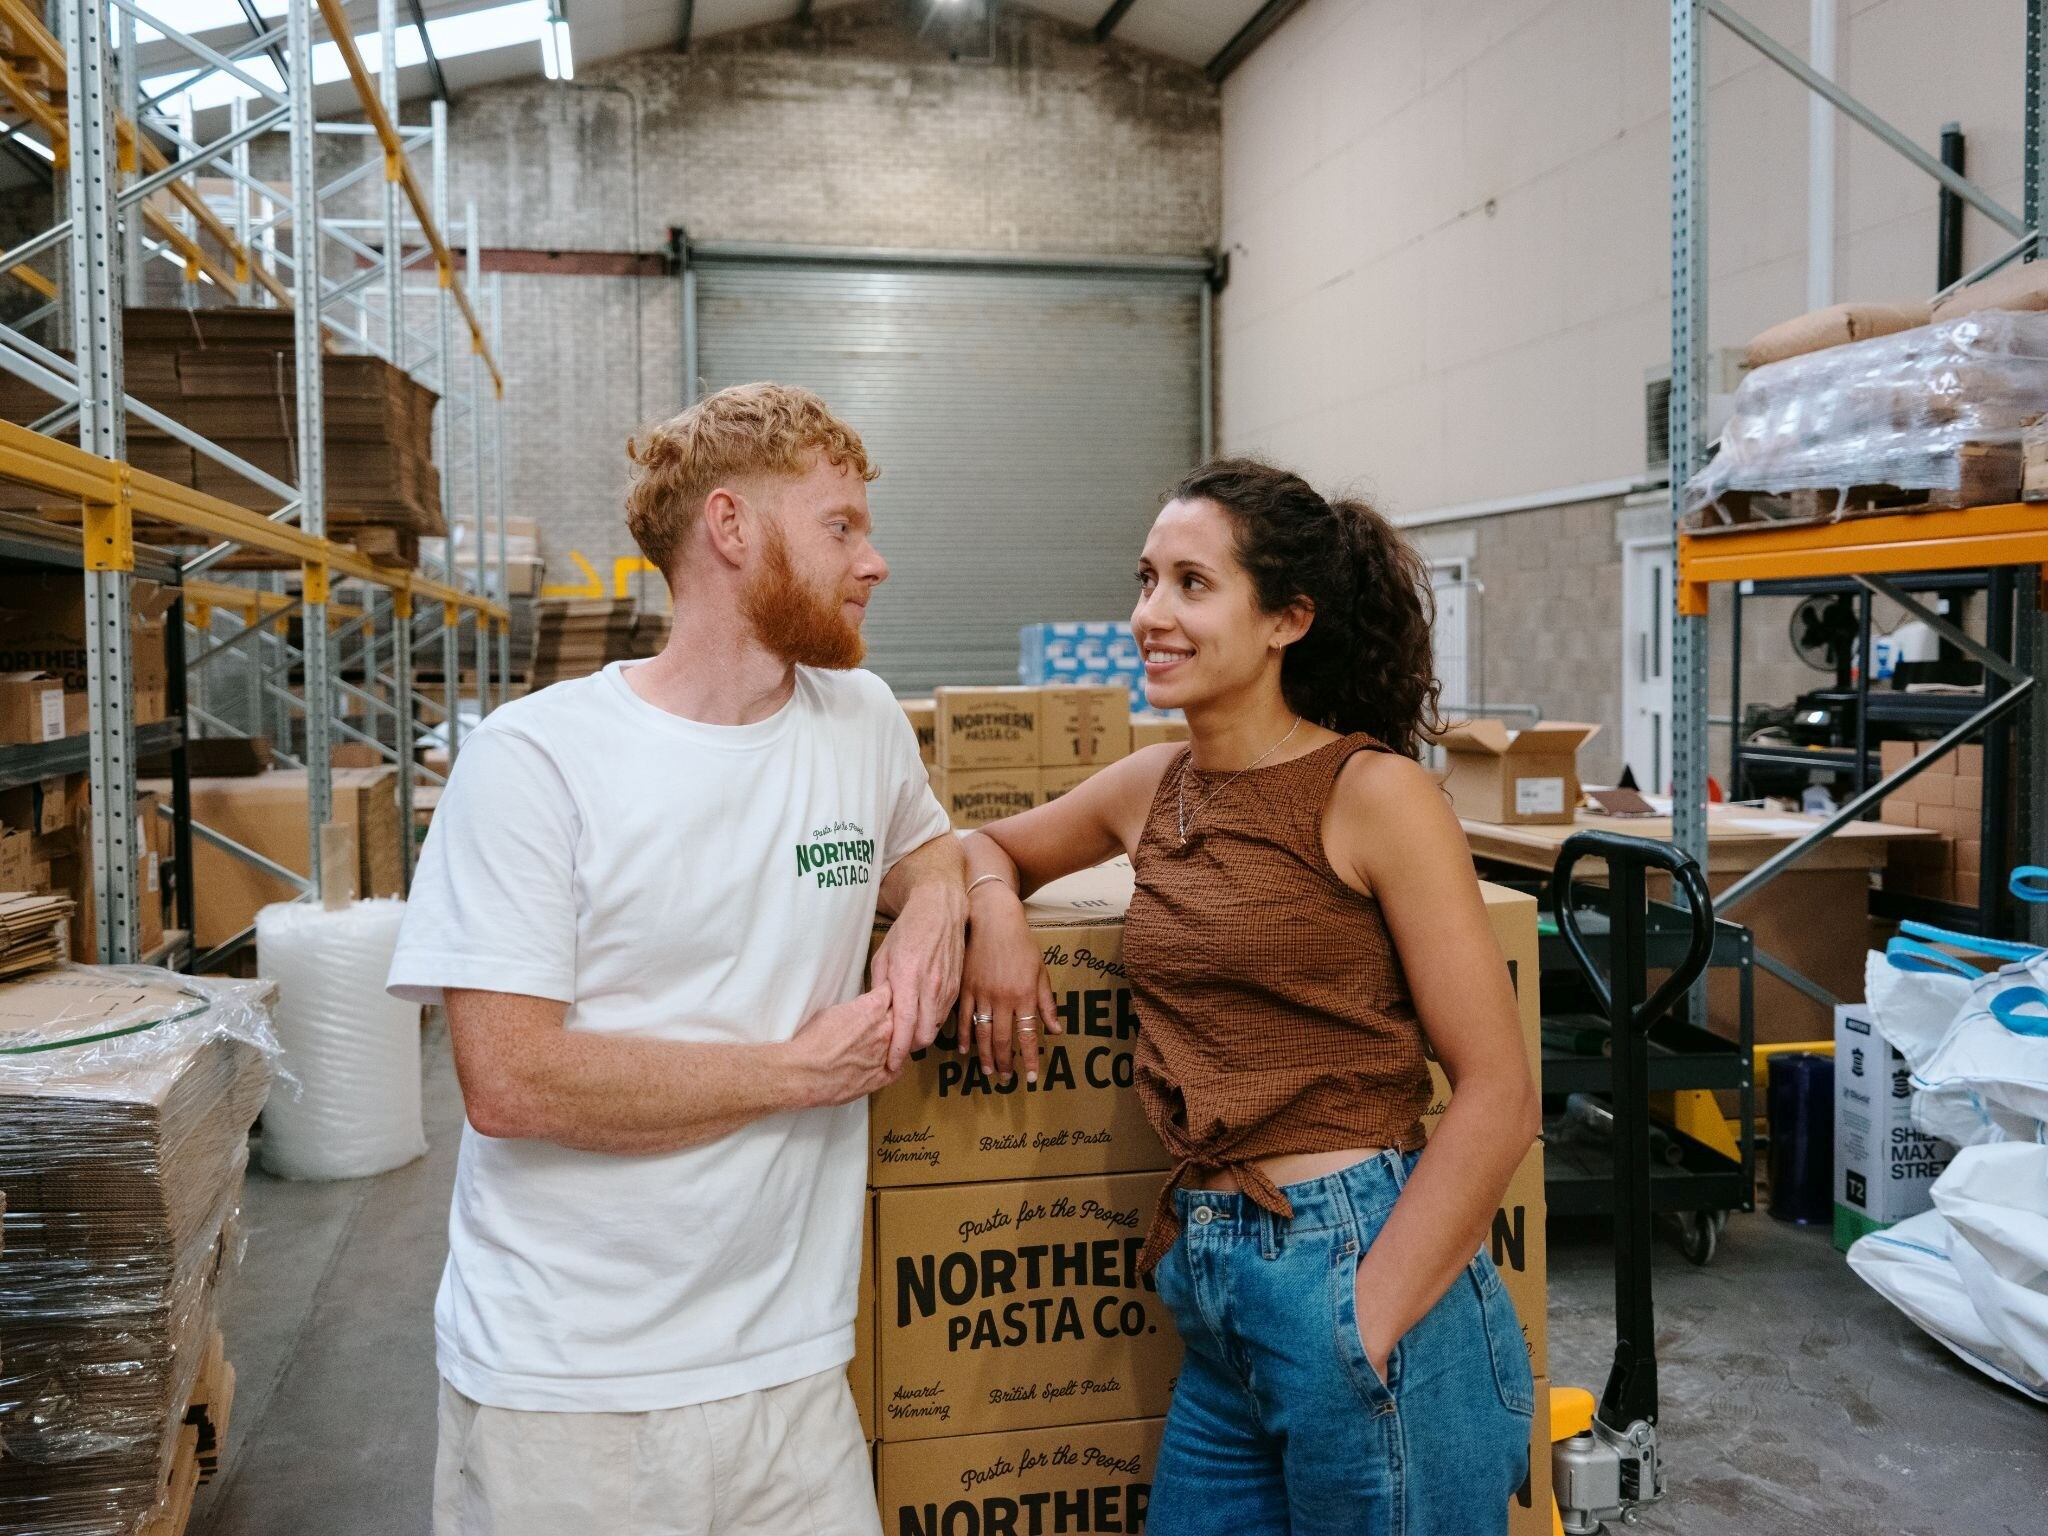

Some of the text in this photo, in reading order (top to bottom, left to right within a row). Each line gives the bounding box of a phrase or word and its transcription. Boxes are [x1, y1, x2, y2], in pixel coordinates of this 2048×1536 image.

[952, 712, 1034, 733] NORTHERN
[817, 865, 857, 888] PASTA
[1043, 945, 1069, 966] the
[979, 1128, 1113, 1152] British Spelt Pasta
[877, 1147, 941, 1167] Winning
[1891, 1144, 1936, 1162] MAX
[1848, 1179, 1865, 1199] T2
[958, 1197, 1140, 1243] Pasta for the People
[896, 1237, 1157, 1328] NORTHER
[948, 1296, 1085, 1352] PASTA
[989, 1376, 1121, 1404] British Spelt Pasta
[887, 1401, 951, 1421] Winning
[960, 1445, 1142, 1492] Pasta for the People
